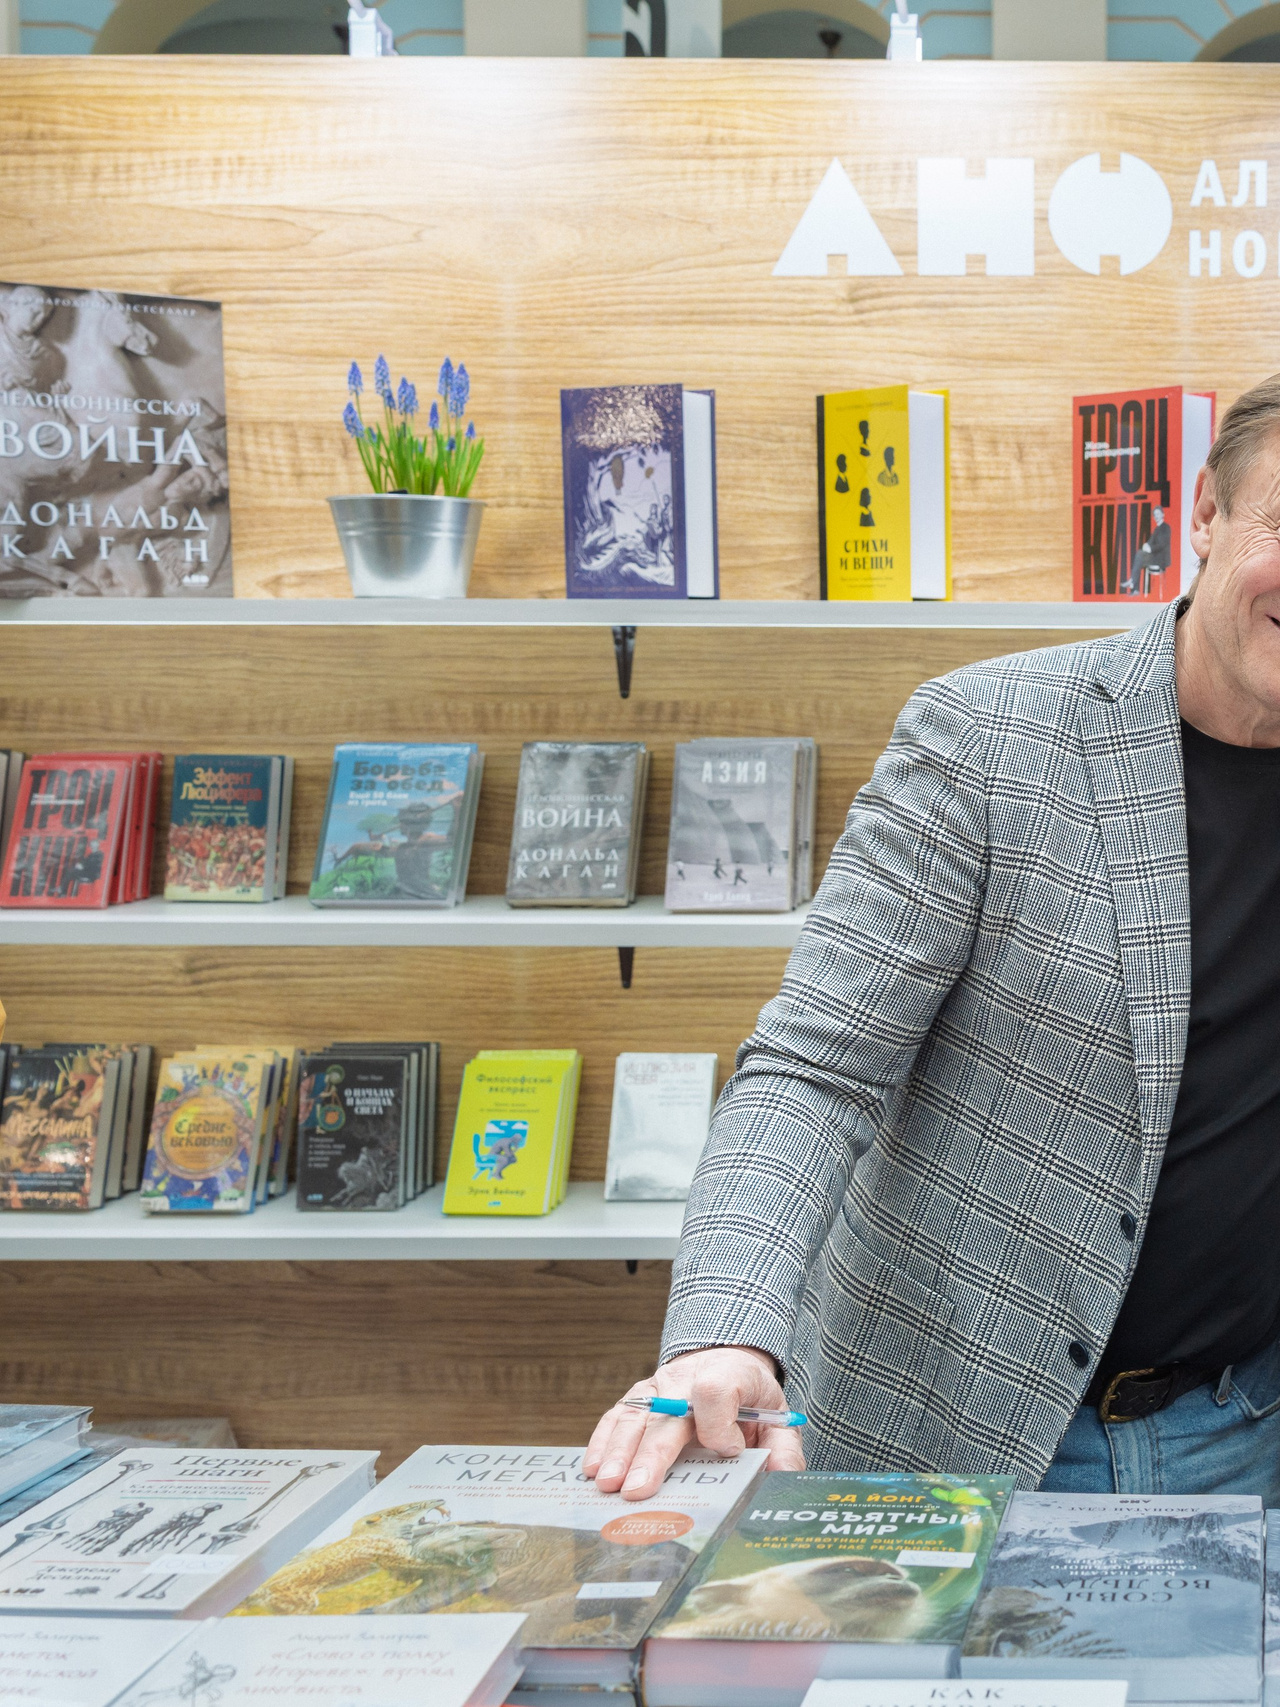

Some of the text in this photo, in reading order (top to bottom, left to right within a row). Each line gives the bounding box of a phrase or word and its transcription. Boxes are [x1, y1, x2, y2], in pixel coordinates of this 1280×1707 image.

[0, 414, 208, 467] ВОЙНА
[1079, 397, 1171, 508] ТРОЦ
[0, 500, 209, 531] ДОНАЛЬД
[3, 534, 209, 563] КАГАН
[843, 539, 889, 555] СТИХИ
[839, 556, 895, 572] И ВЕЩИ
[353, 760, 447, 779] Борьба
[701, 760, 768, 784] АЗИЯ
[350, 777, 445, 793] за обед
[522, 803, 624, 830] ВОЙНА
[517, 847, 620, 862] ДОНАЛЬД
[516, 863, 618, 879] КАГАН
[169, 1455, 303, 1469] Первые
[435, 1452, 584, 1468] КОНЕЦ
[684, 1457, 740, 1466] МАКФИ
[175, 1466, 267, 1478] шаги
[455, 1468, 731, 1485] МЕГАНЫ
[825, 1492, 926, 1504] ЭД ЙОНГ
[748, 1508, 983, 1526] НЕОБЪЯТНЫЙ
[618, 1522, 677, 1531] ПИТЕРА
[820, 1524, 899, 1536] МИР
[793, 1536, 868, 1544] ЖИВОТНЫЕ
[873, 1538, 945, 1547] ОЩУЩАЮТ
[1031, 1578, 1211, 1590] ВО ЛЬДАХ
[1066, 1591, 1173, 1603] СОВЫ
[930, 1687, 1005, 1700] КАК
